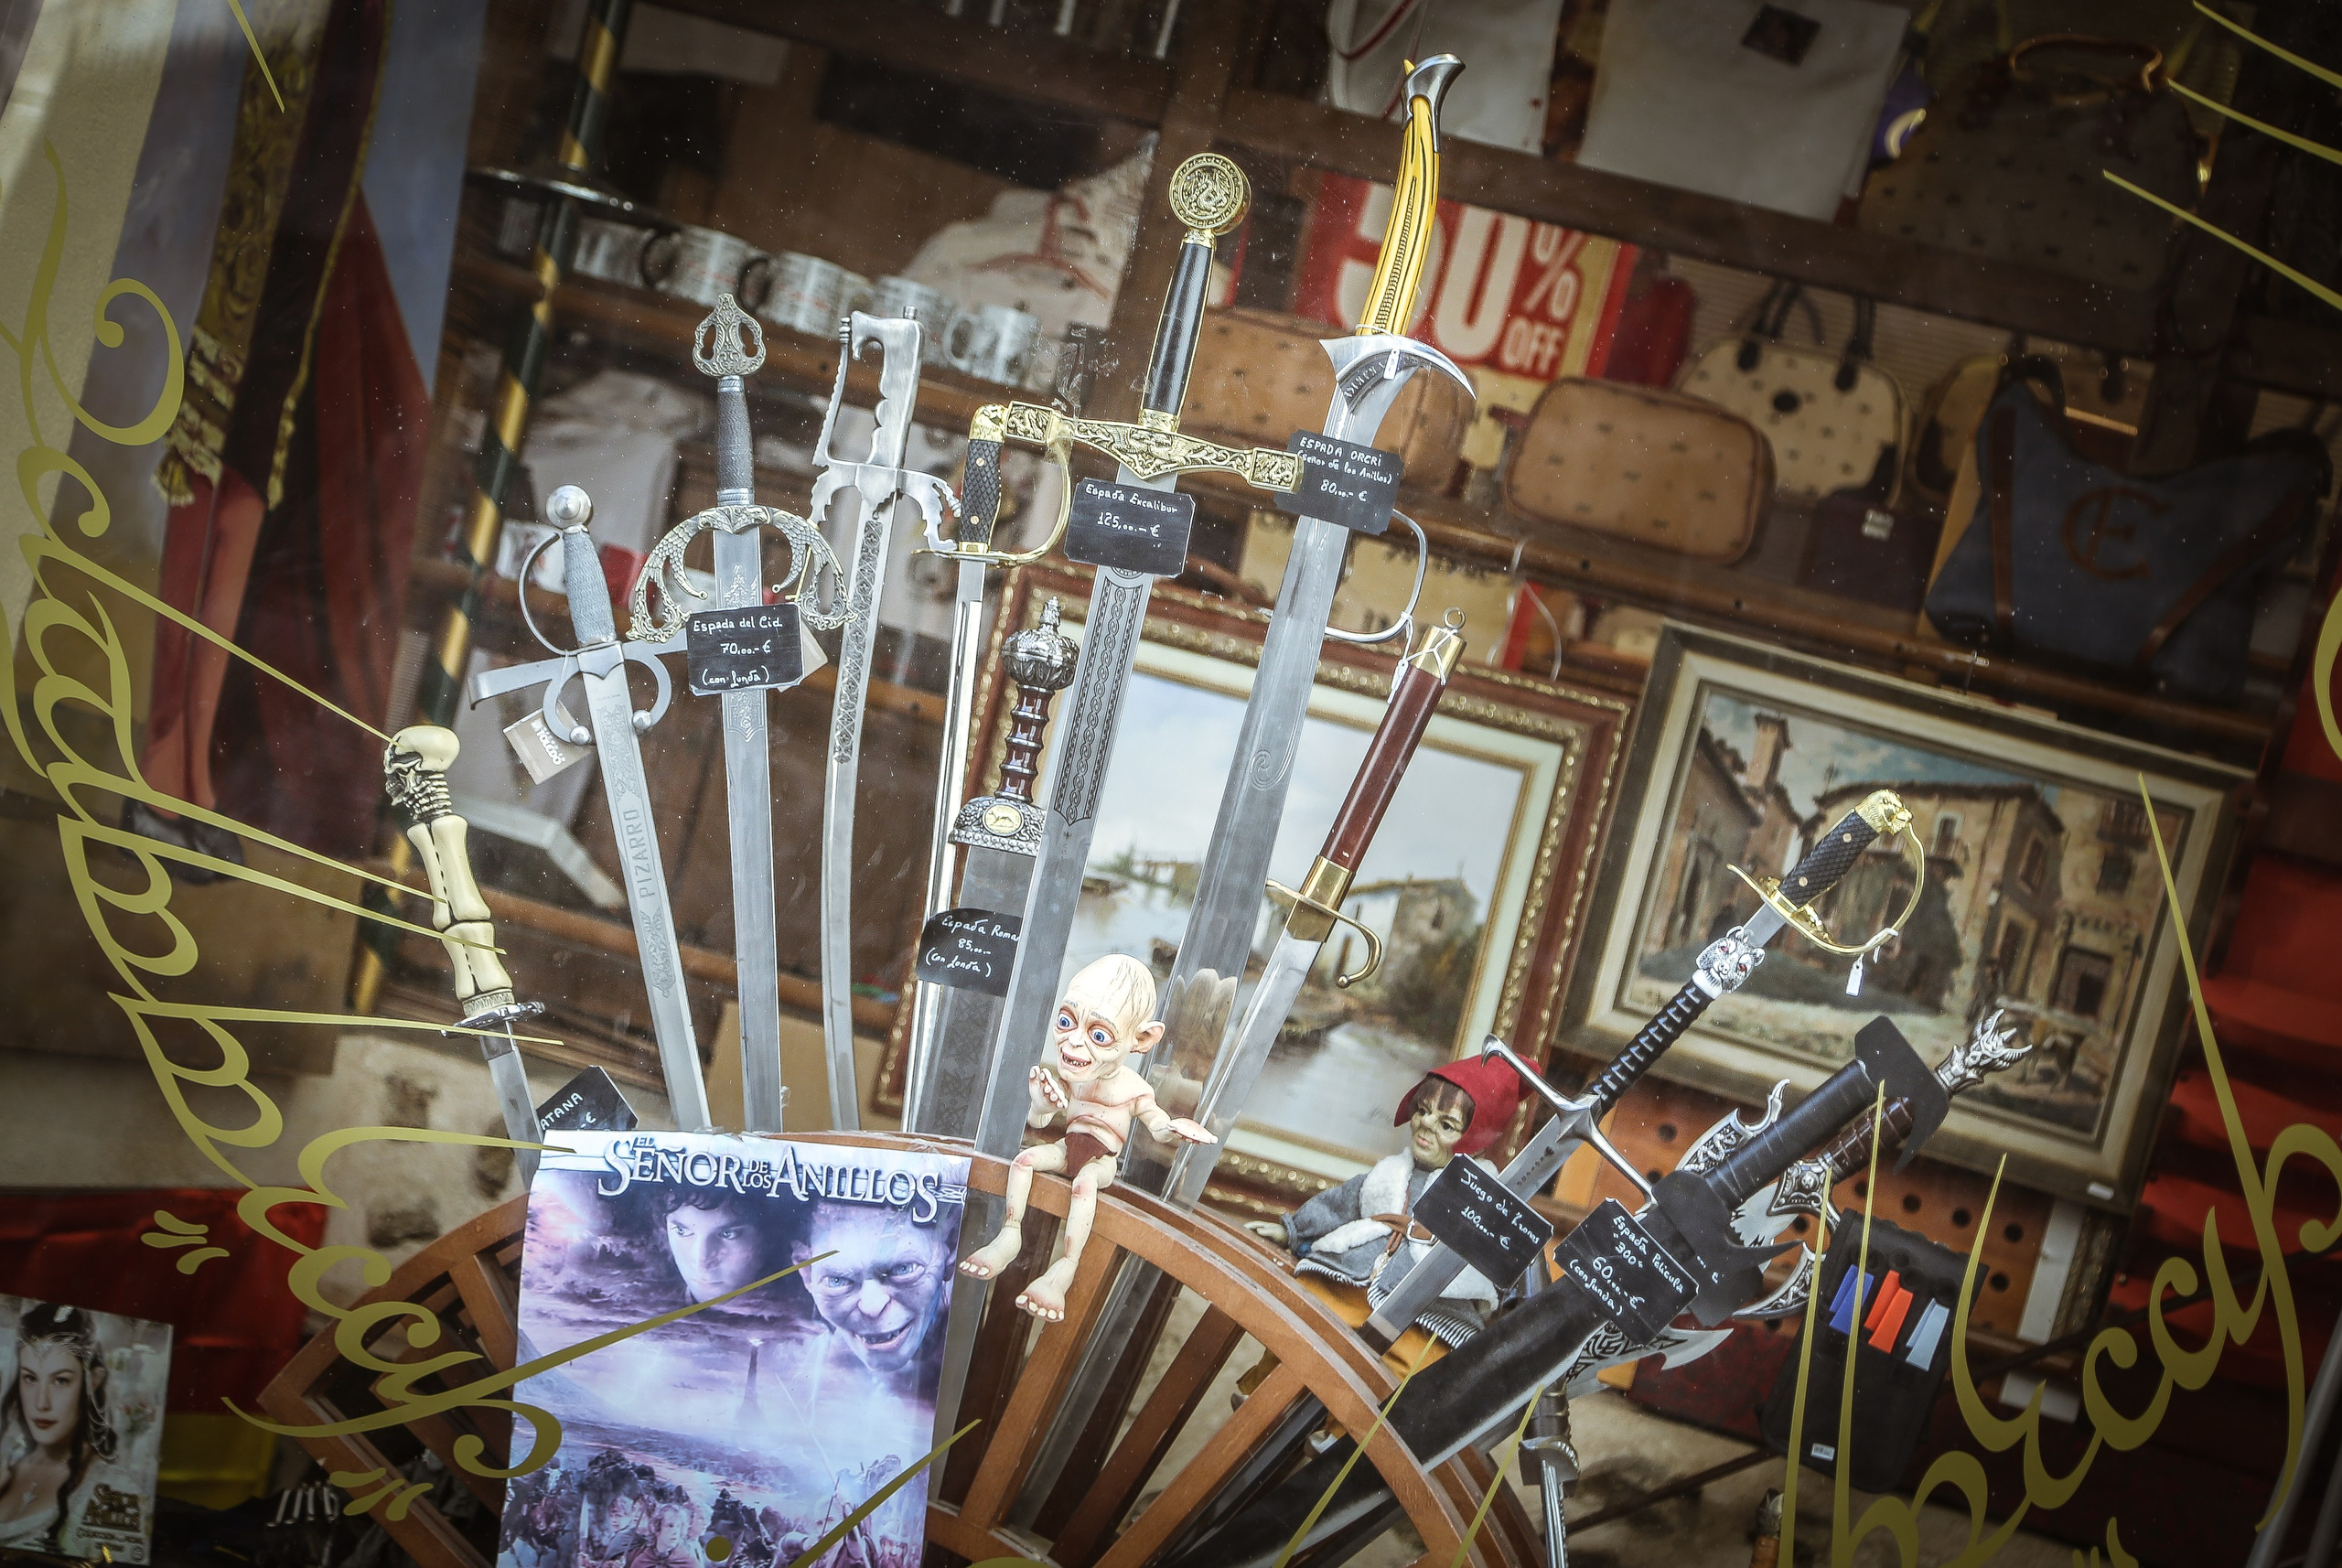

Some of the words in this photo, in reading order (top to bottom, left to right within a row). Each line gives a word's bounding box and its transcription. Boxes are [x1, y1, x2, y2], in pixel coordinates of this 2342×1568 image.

[1503, 318, 1561, 374] OFF
[1299, 436, 1343, 457] ESPADA
[1085, 483, 1125, 502] Espada
[1129, 492, 1178, 513] Excalibur
[1358, 490, 1368, 502] €
[1150, 524, 1161, 538] €
[693, 620, 736, 636] Espada
[739, 616, 756, 629] del
[758, 615, 783, 629] Cid
[762, 639, 771, 654] €
[623, 809, 656, 900] PIZARRO
[941, 915, 988, 934] Espada
[540, 1091, 584, 1131] ATANA
[630, 1135, 655, 1148] EL
[597, 1140, 747, 1198] SEÑOR
[747, 1159, 768, 1174] DE
[742, 1173, 772, 1190] LOS
[766, 1145, 940, 1224] ANILLOS
[1460, 1167, 1493, 1203] Juego
[1496, 1198, 1509, 1217] de
[1499, 1234, 1511, 1251] €
[1613, 1215, 1649, 1256] Espada
[1629, 1295, 1646, 1310] €
